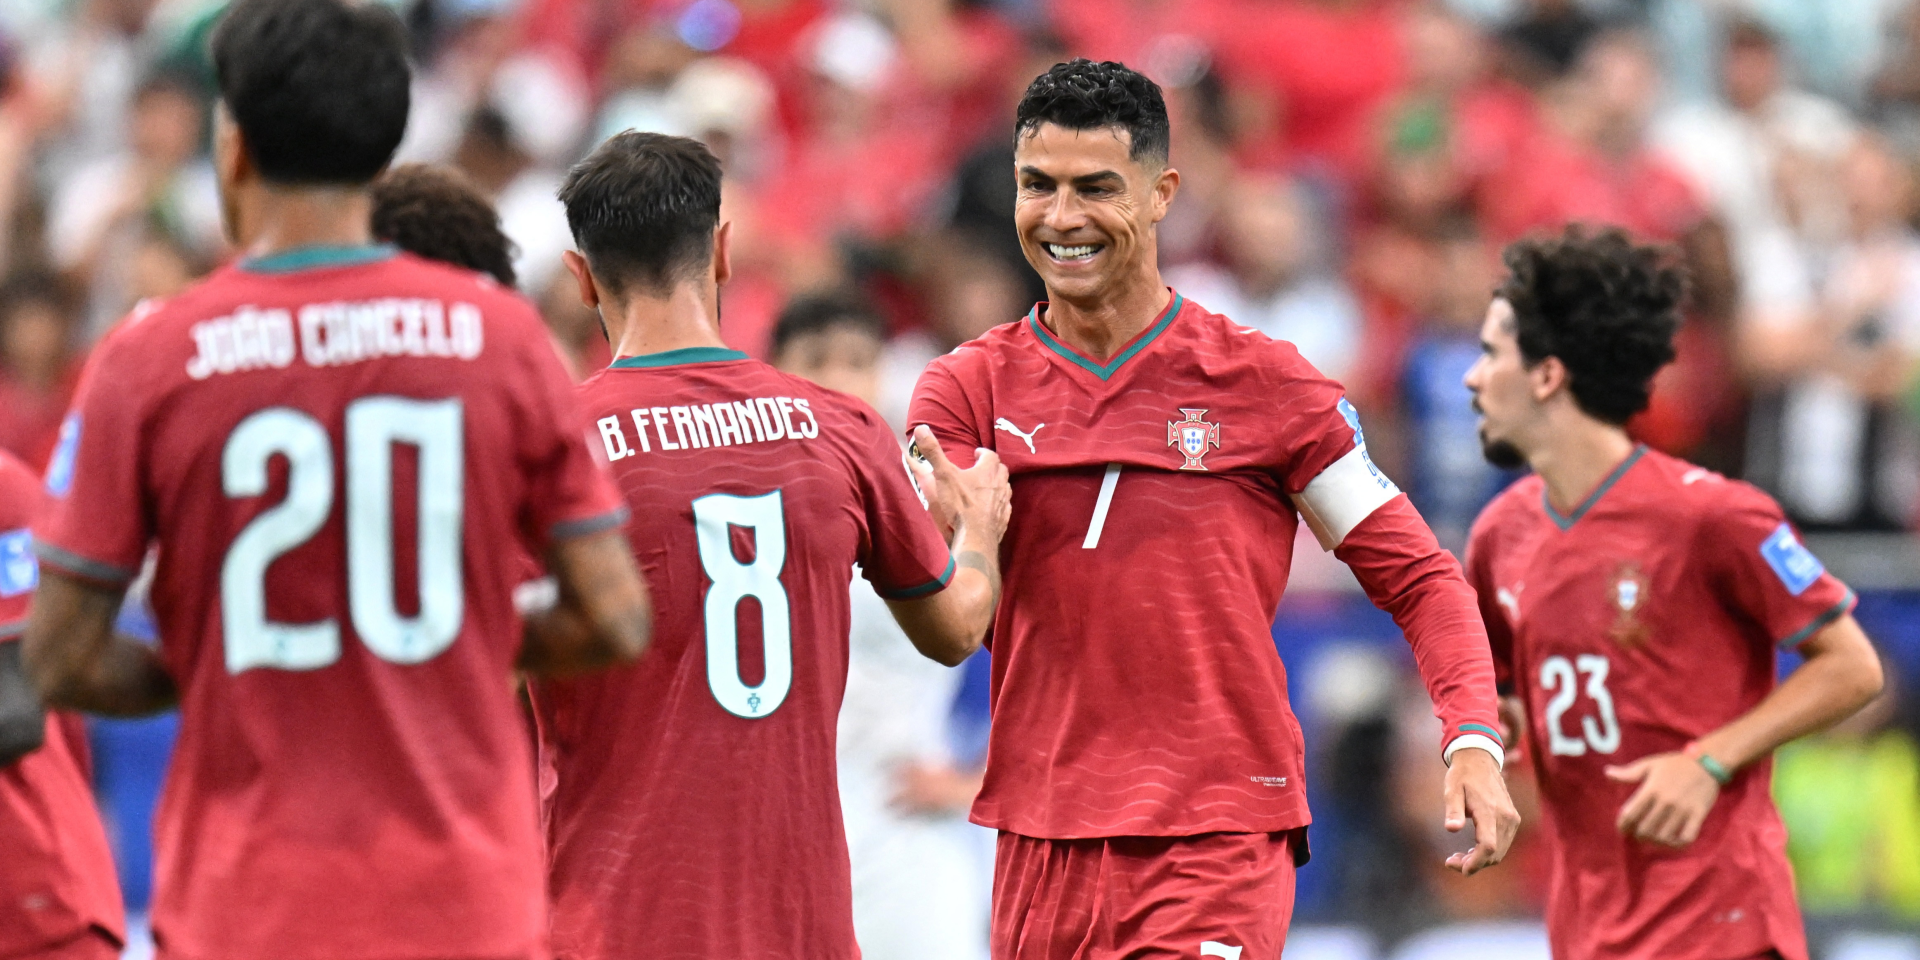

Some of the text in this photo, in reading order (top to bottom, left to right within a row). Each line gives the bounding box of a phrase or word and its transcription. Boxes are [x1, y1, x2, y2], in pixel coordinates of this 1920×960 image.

[187, 297, 484, 379] JOÃO CANCELO
[597, 397, 818, 461] B. FERNANDES
[221, 395, 465, 675] 20
[692, 487, 793, 719] 8
[1540, 654, 1620, 756] 23
